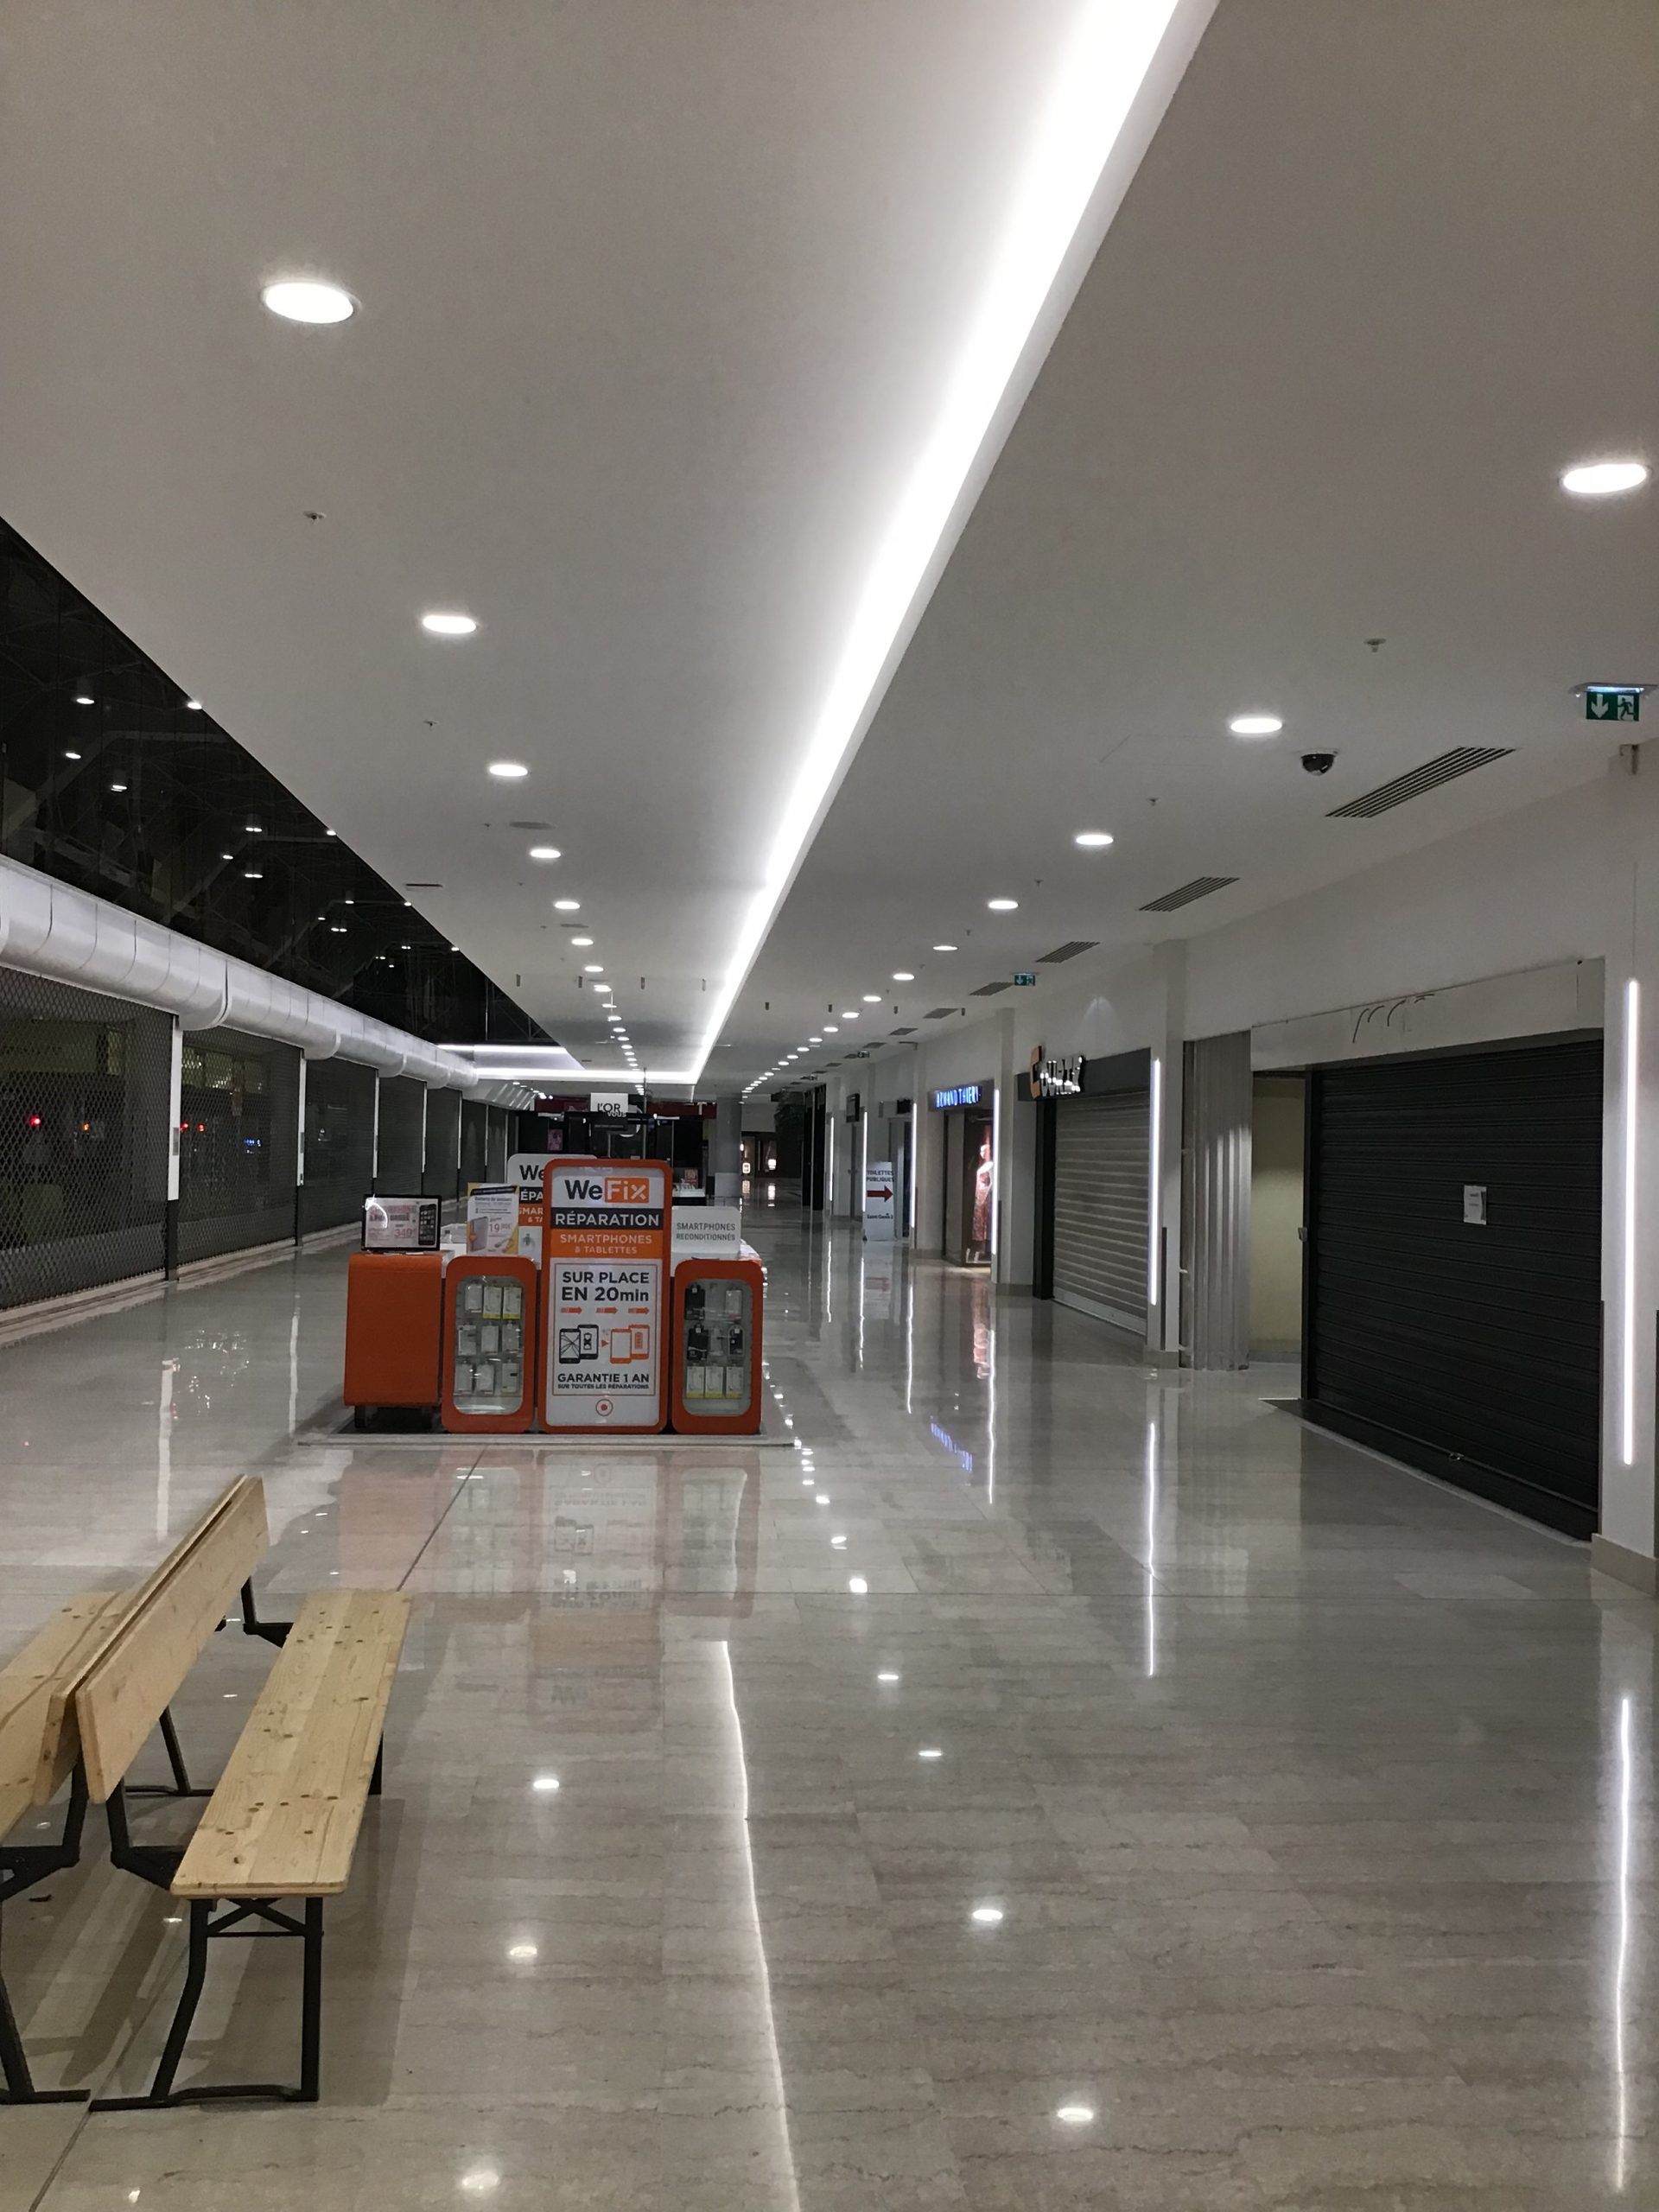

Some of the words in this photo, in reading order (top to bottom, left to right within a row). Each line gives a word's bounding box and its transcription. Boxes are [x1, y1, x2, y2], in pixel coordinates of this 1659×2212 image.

[564, 1179, 646, 1200] WeFix
[555, 1211, 659, 1226] RÉPARATION
[677, 1222, 736, 1231] SMARTPHONES
[560, 1234, 652, 1244] SMARTPHONES
[676, 1232, 736, 1242] RECONDITIONNÉS
[583, 1245, 638, 1255] TABLETTES
[563, 1271, 594, 1284] SUR
[599, 1271, 650, 1284] PLACE
[562, 1287, 588, 1301] EN
[594, 1287, 649, 1302] 20min
[557, 1373, 620, 1382] GARANTIE
[623, 1373, 628, 1383] 1
[632, 1373, 650, 1383] AN
